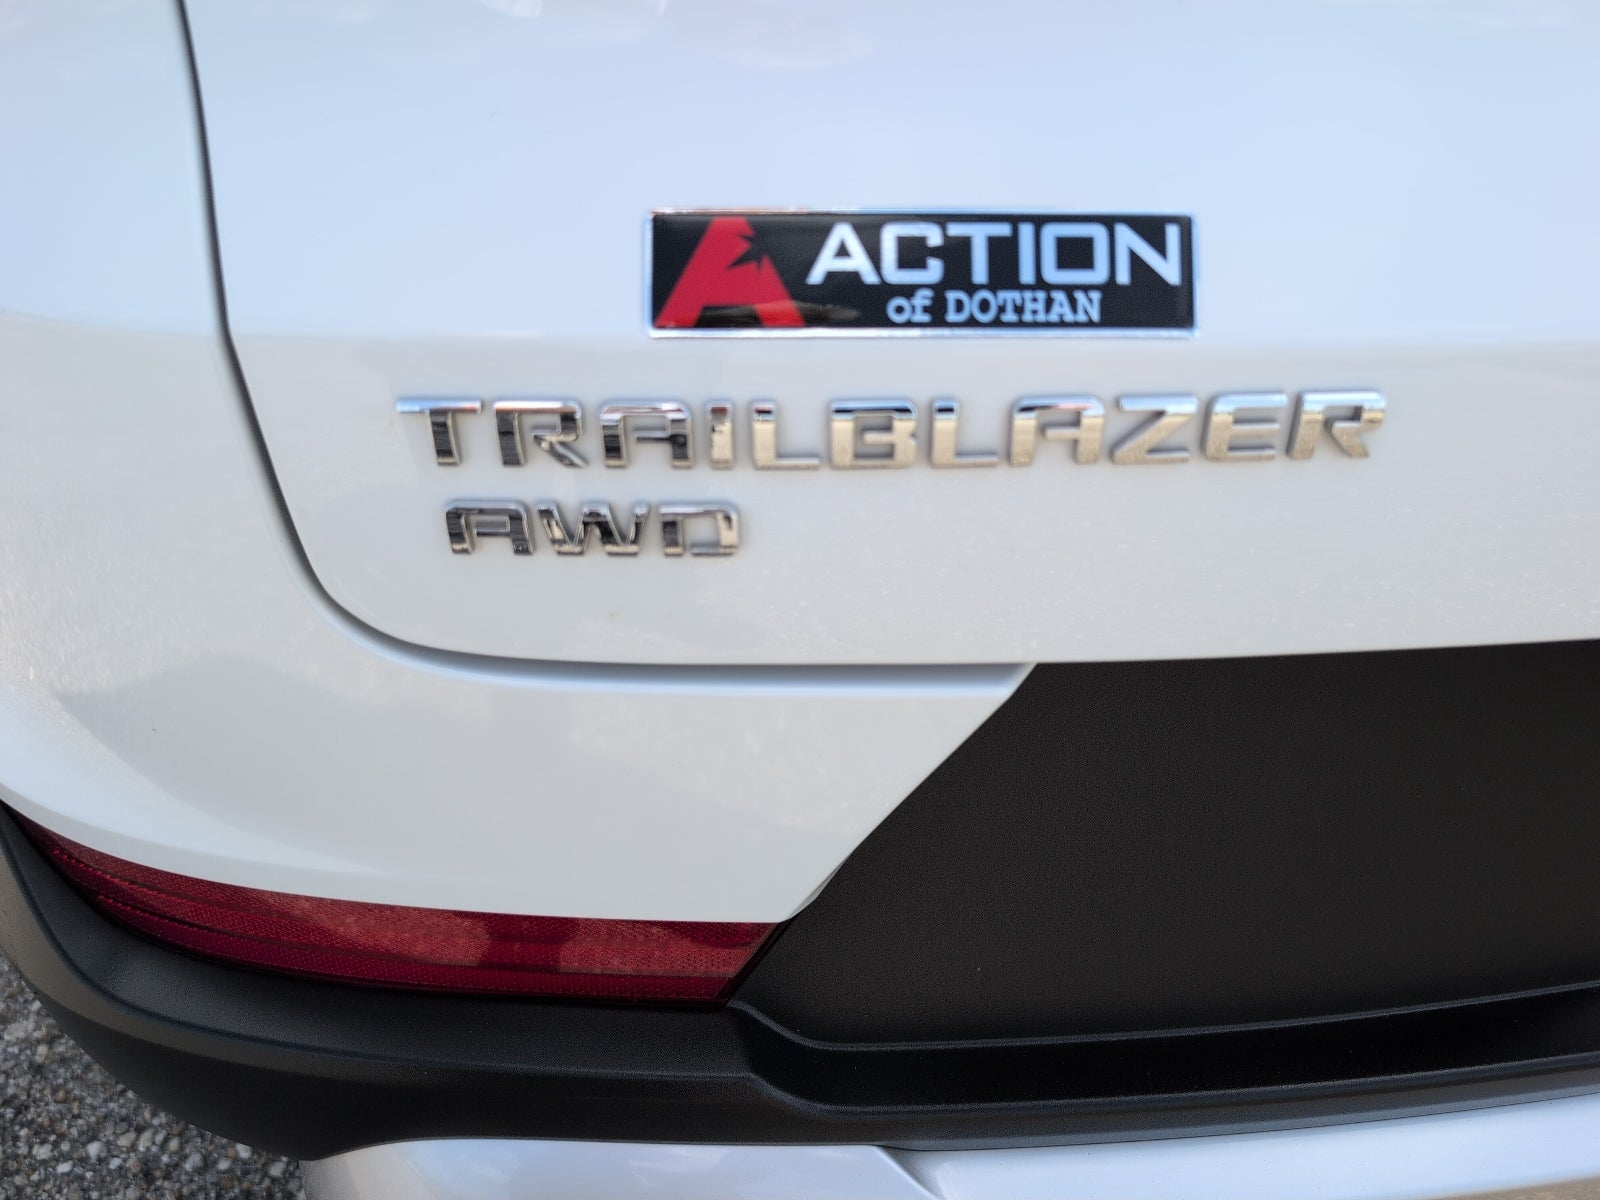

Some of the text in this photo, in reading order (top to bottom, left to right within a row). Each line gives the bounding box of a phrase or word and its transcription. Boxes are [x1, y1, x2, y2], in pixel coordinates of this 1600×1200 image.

[806, 221, 1182, 286] ACTION
[886, 290, 1102, 324] of DOTHAN
[396, 389, 1388, 470] TRAILBLAZER
[444, 500, 741, 557] AWD
